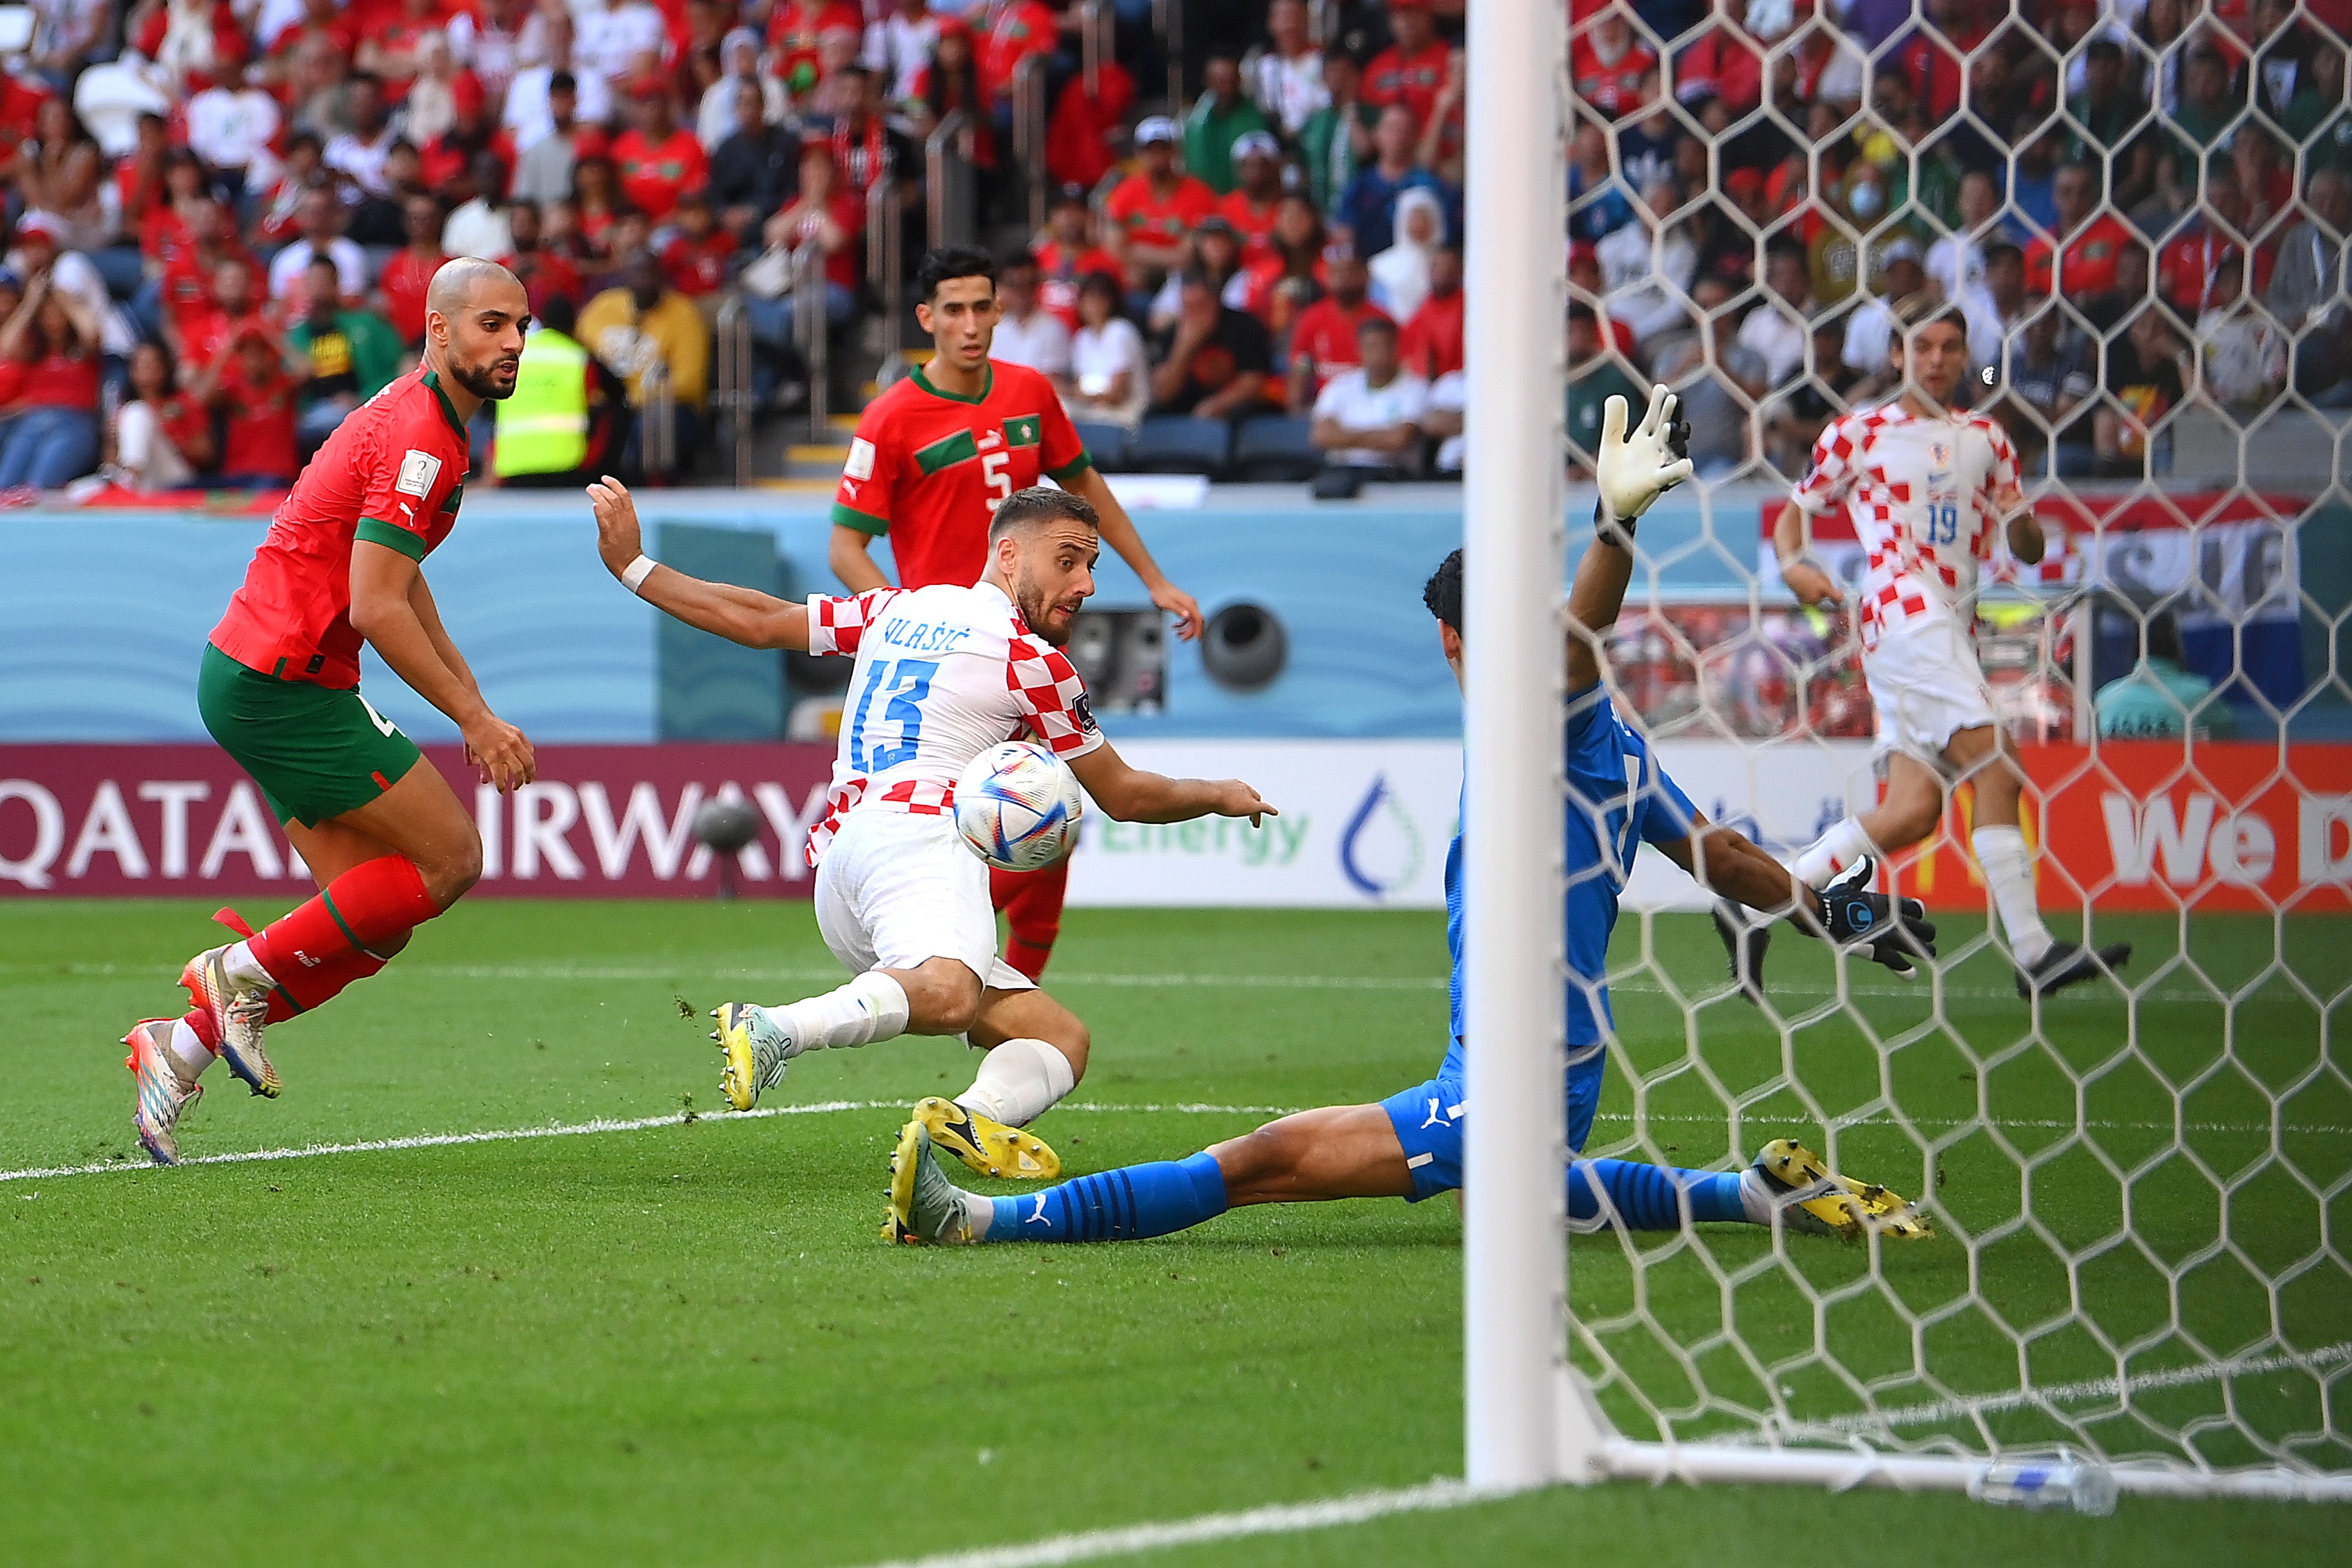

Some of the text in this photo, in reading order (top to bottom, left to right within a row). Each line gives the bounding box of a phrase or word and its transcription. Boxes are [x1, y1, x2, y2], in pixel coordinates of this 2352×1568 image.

[982, 451, 1012, 512] 5
[1927, 504, 1957, 545] 19
[850, 659, 940, 775] 13
[0, 779, 829, 889] QATA IRWAY
[2100, 791, 2276, 889] We
